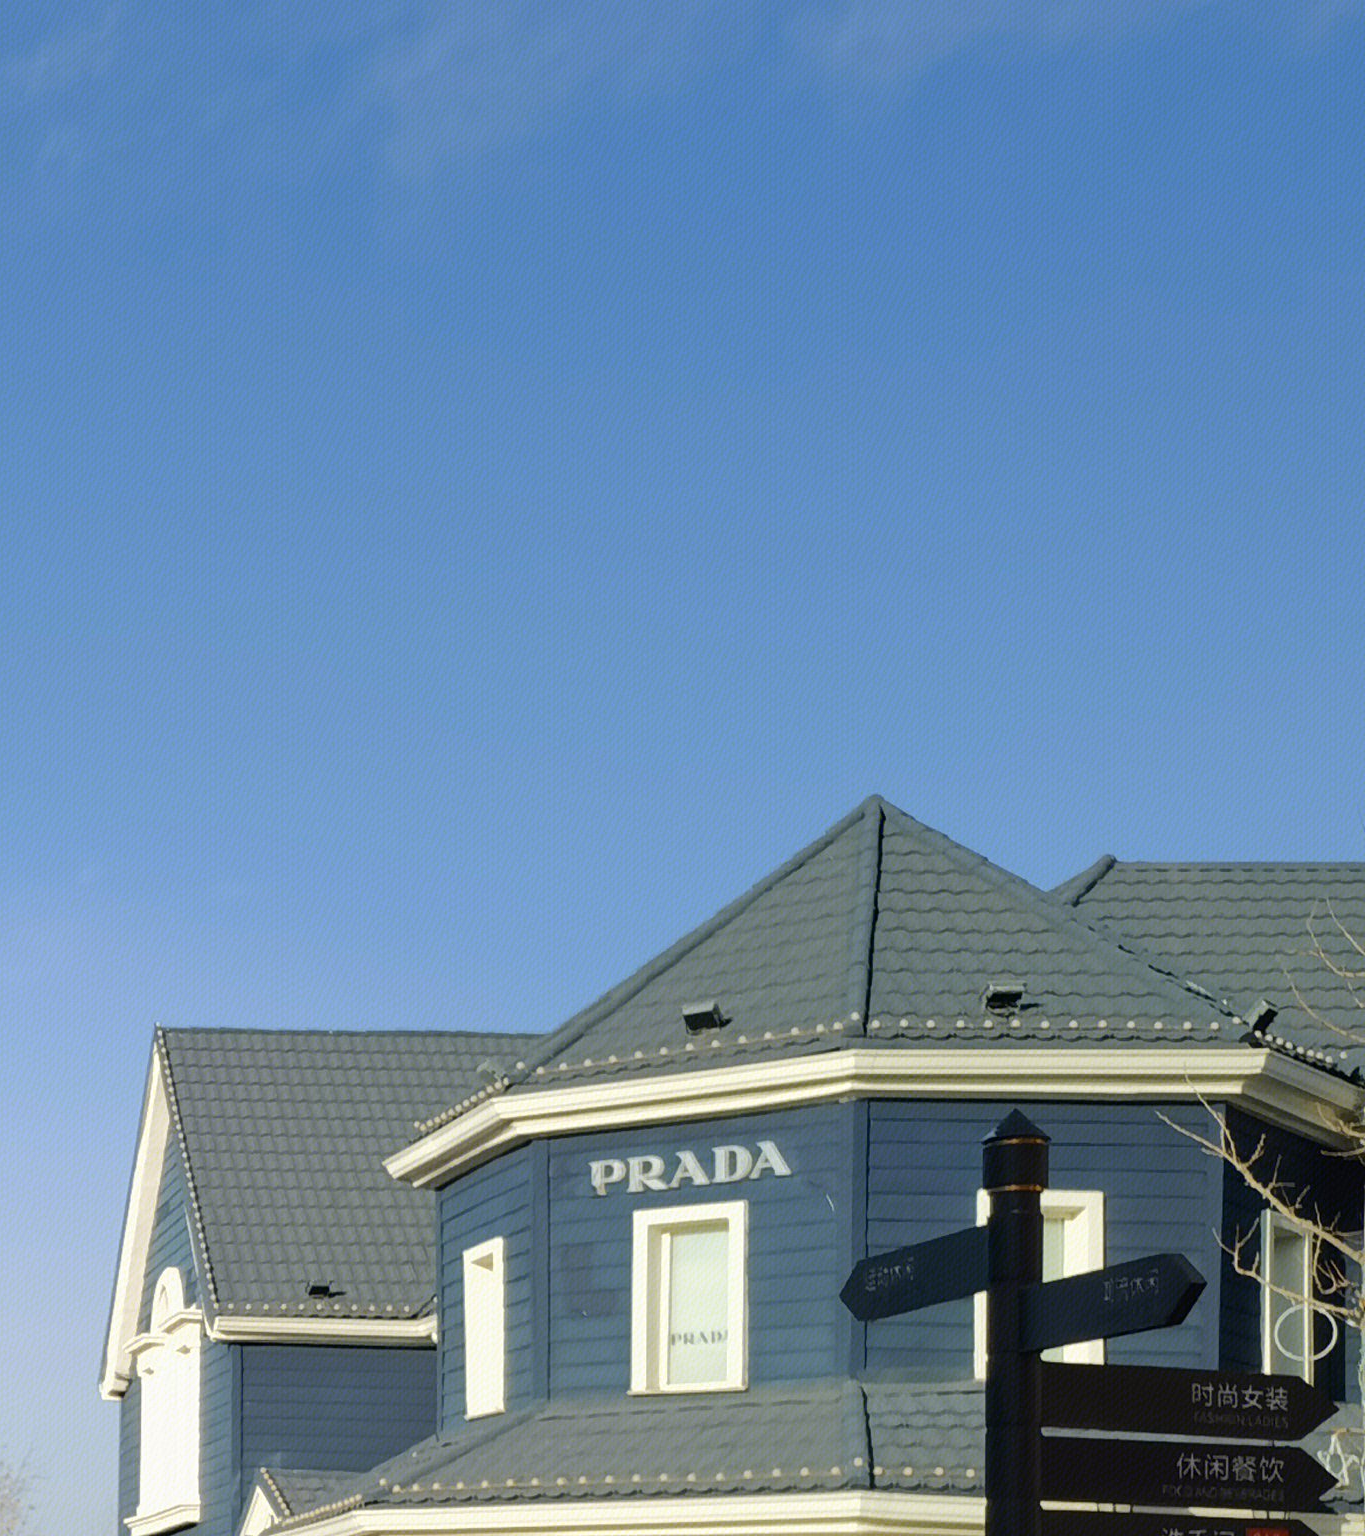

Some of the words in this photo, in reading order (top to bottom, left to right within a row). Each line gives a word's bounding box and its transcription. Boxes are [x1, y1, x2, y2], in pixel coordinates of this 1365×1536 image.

[589, 1140, 792, 1196] PRADA
[1191, 1382, 1289, 1412] 时尚女装
[1176, 1452, 1285, 1483] 休闲餐饮
